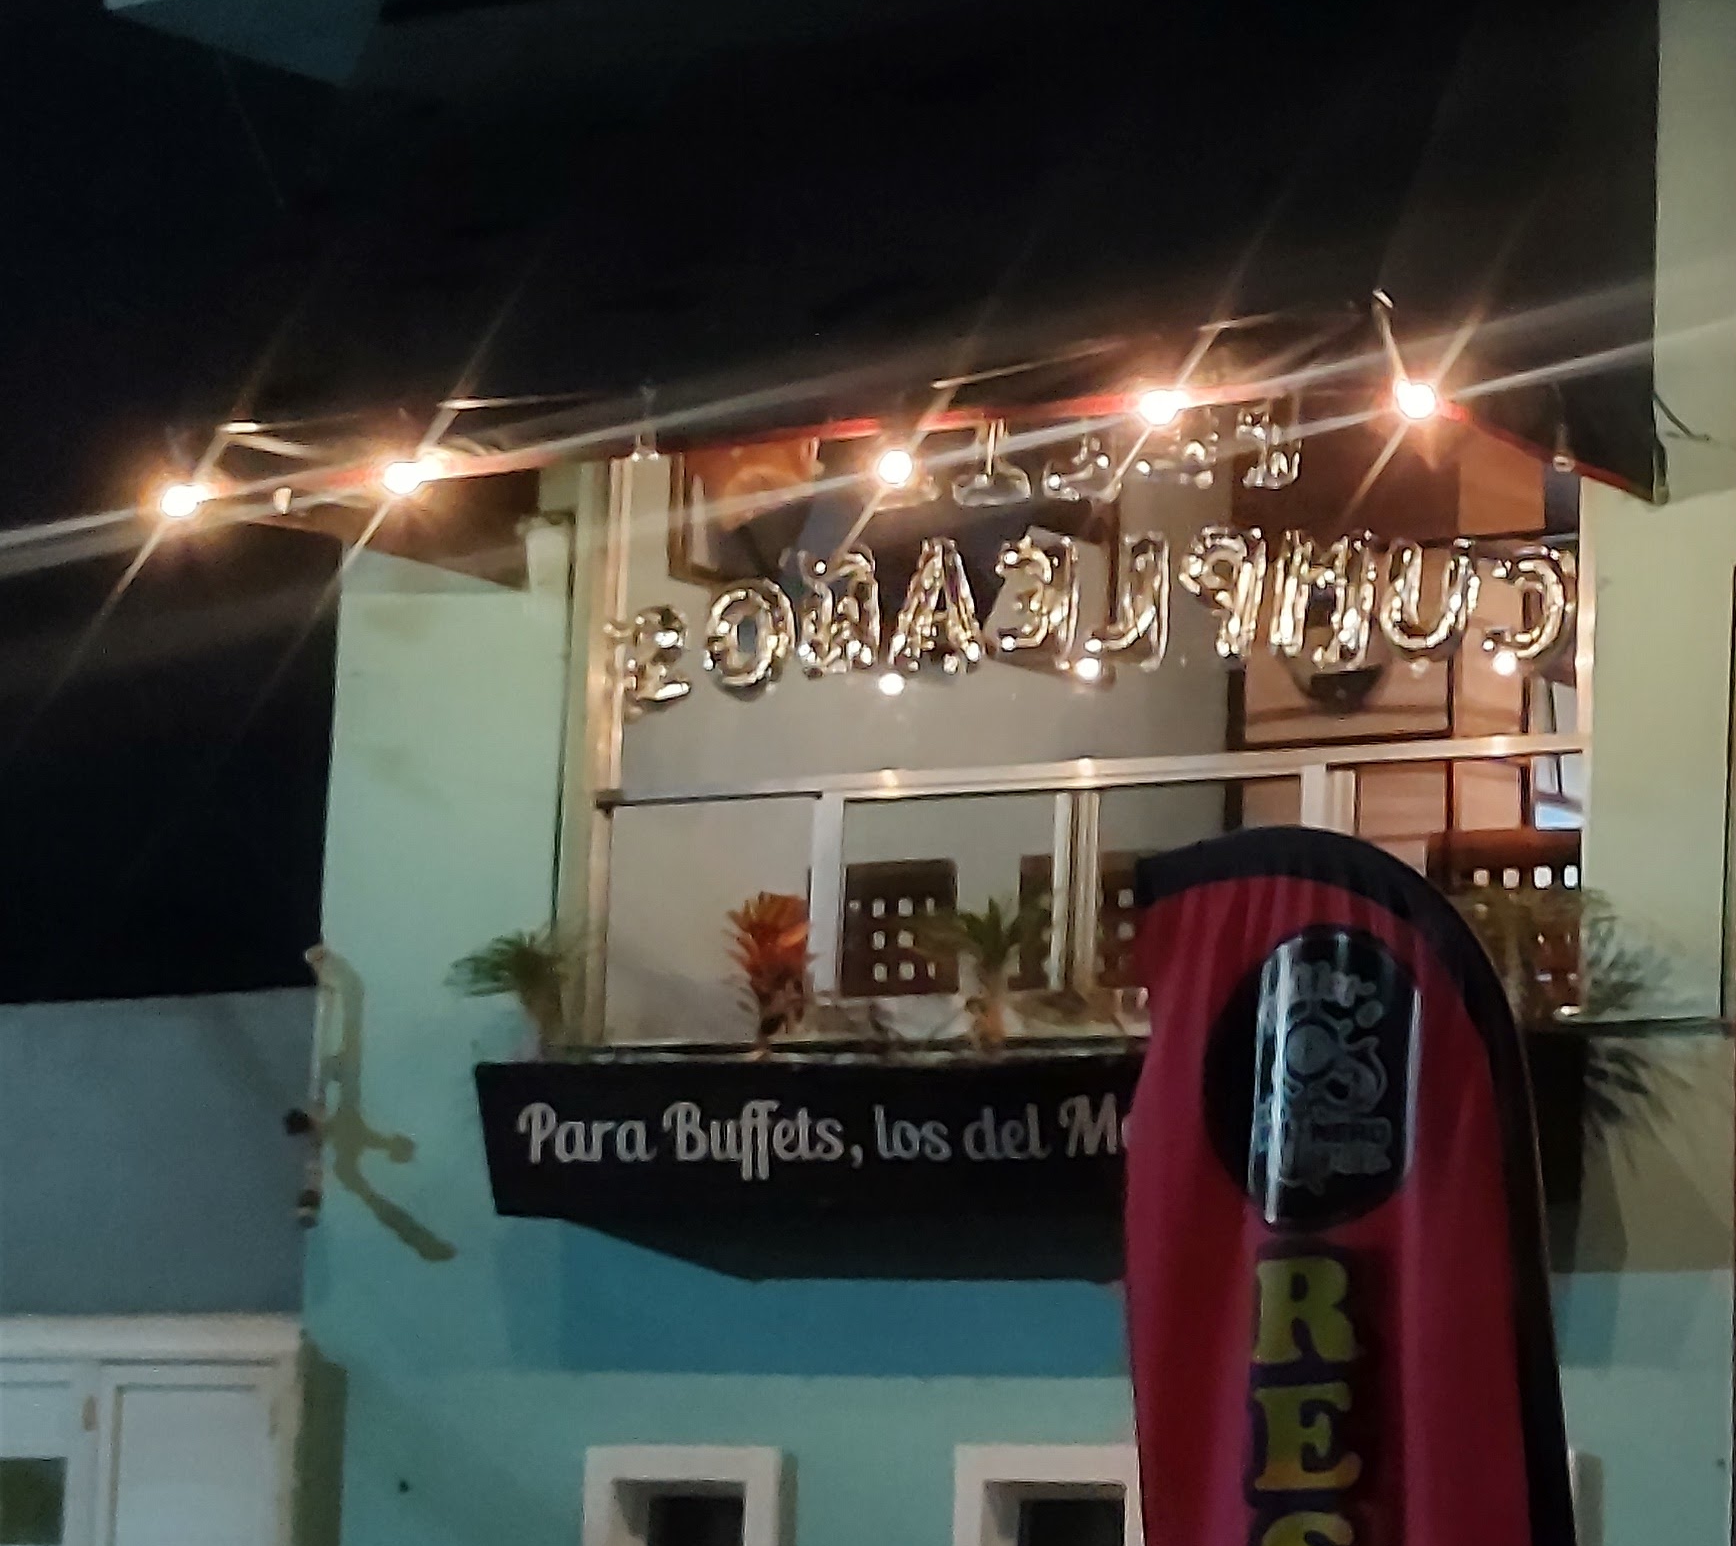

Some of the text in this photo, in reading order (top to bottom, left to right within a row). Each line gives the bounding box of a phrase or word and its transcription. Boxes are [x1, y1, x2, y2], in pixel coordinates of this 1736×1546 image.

[517, 1101, 656, 1165] Para
[660, 1098, 865, 1181] Buffets,
[873, 1105, 952, 1159] los
[962, 1103, 1052, 1160] del
